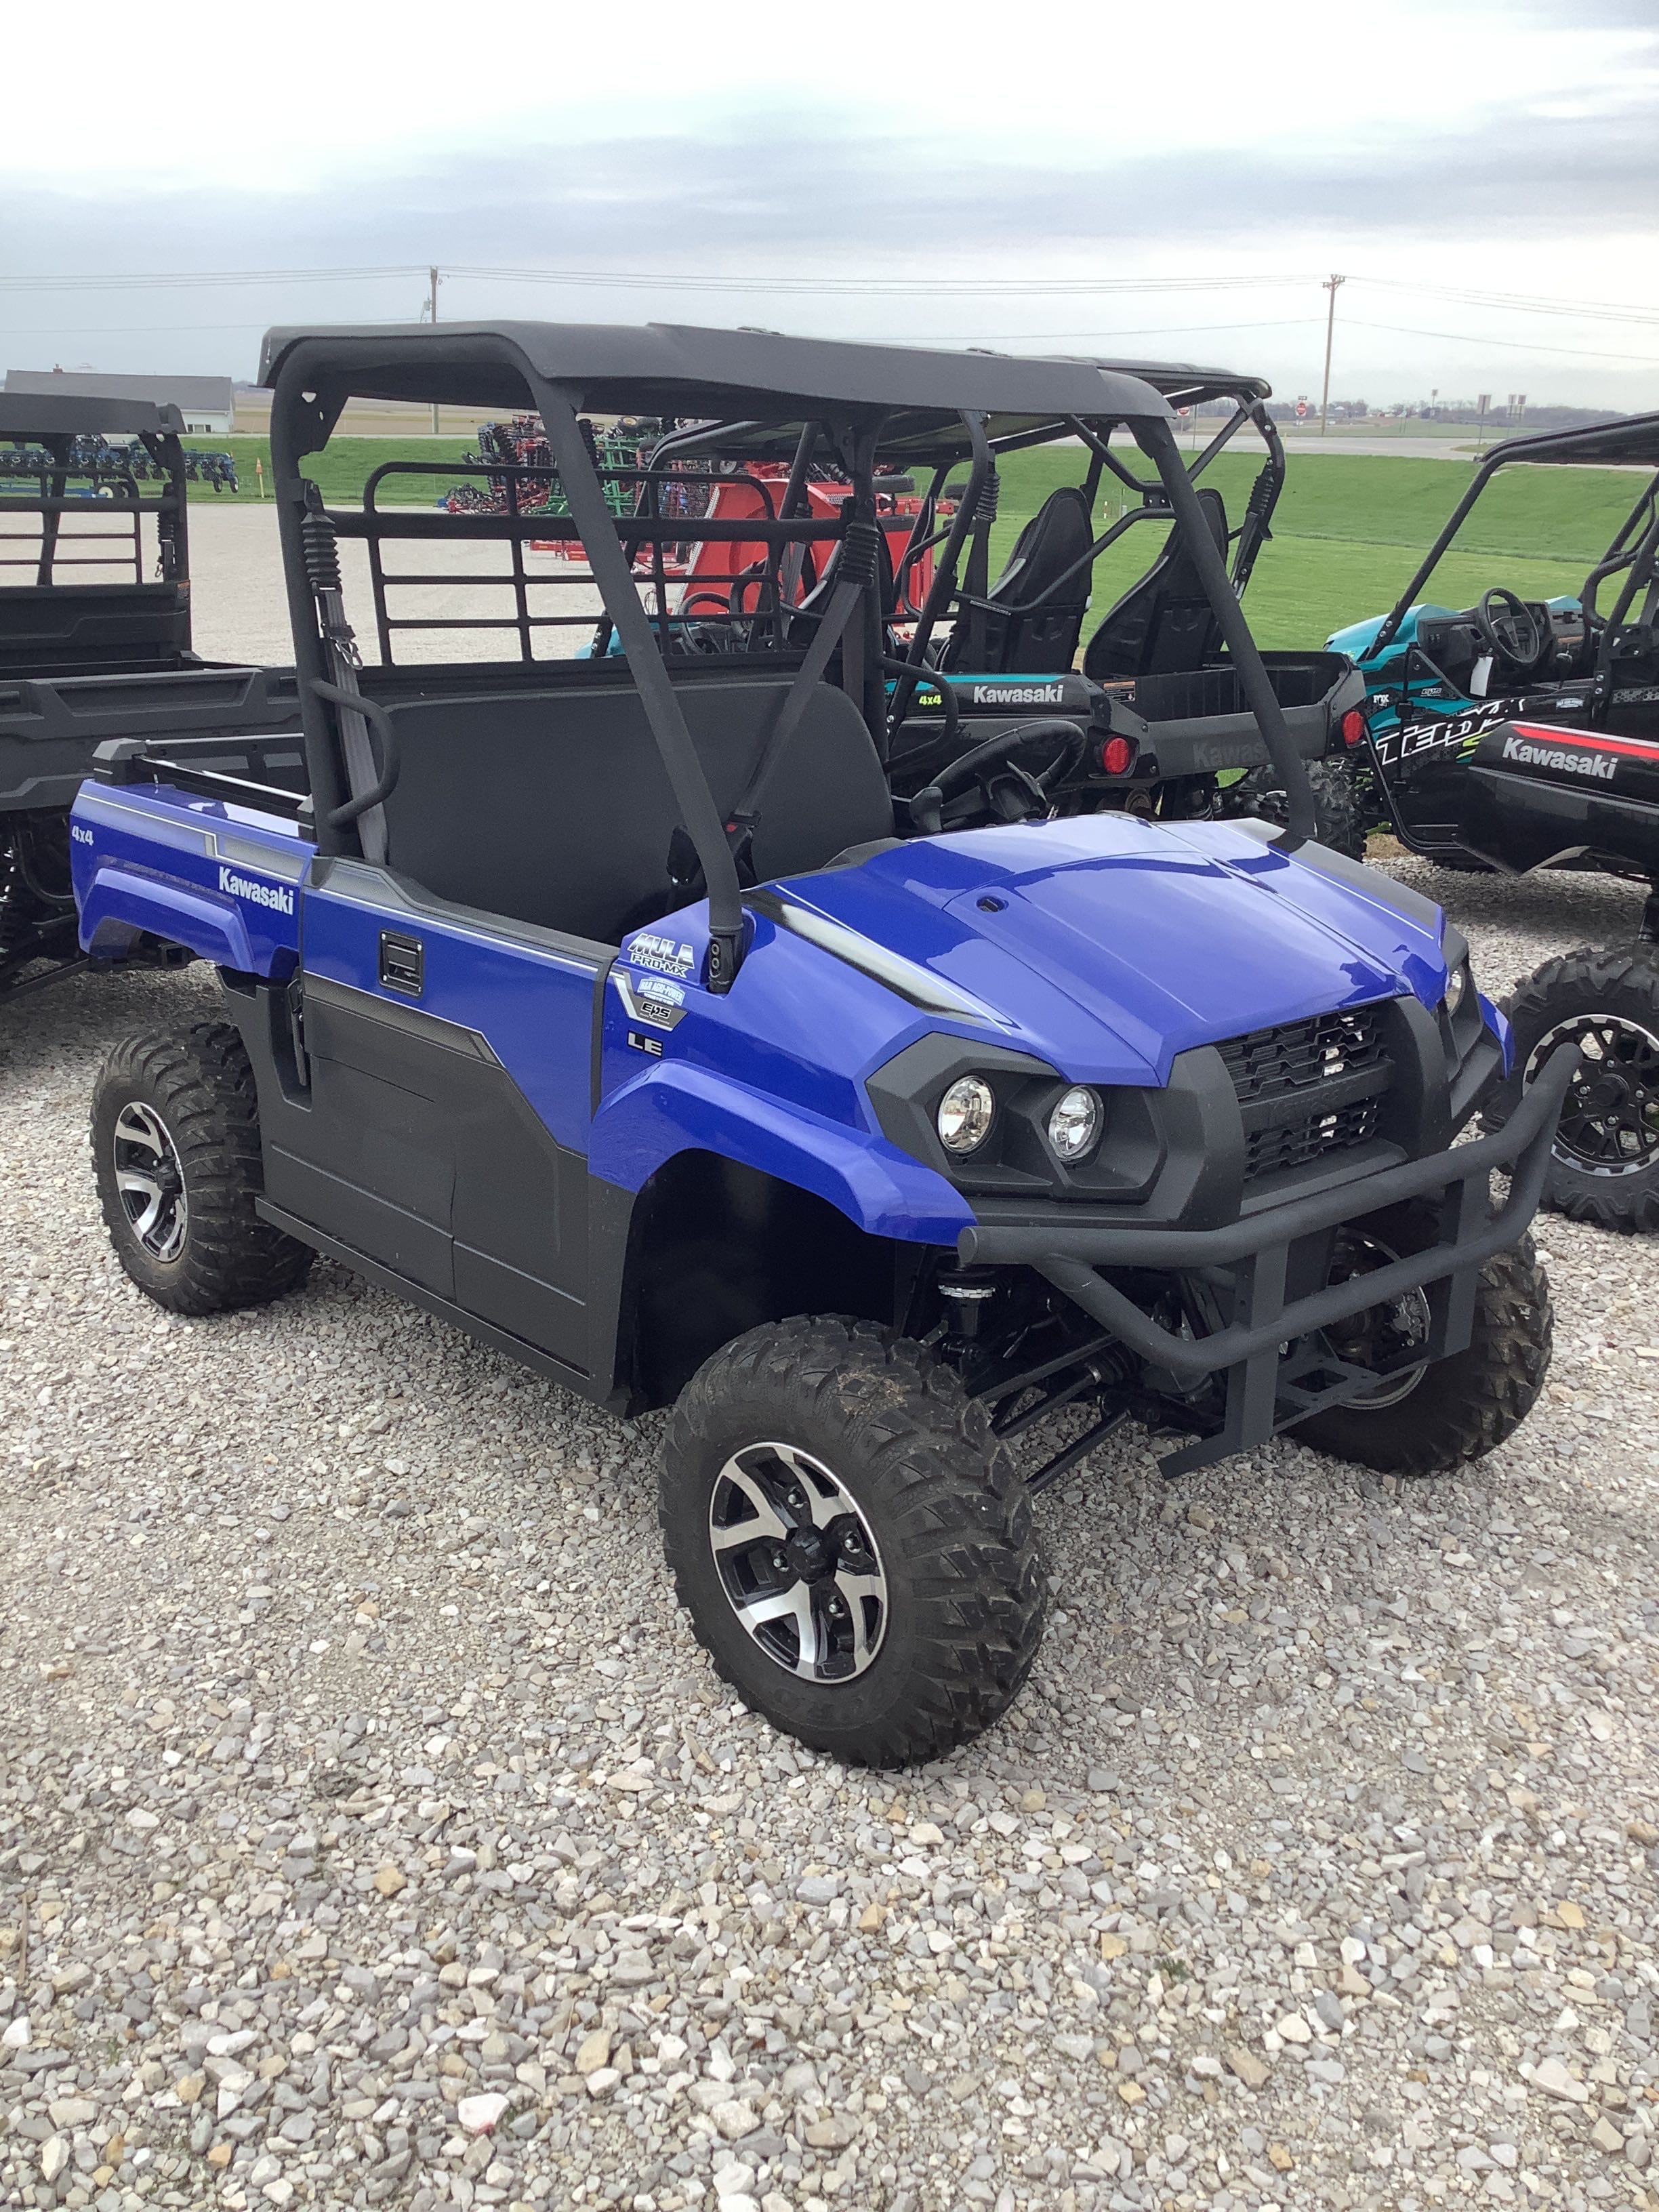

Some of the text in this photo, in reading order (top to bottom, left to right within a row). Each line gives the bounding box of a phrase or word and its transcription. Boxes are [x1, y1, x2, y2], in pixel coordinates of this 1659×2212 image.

[918, 695, 943, 705] 4x4
[973, 684, 1064, 703] Kawasaki
[1192, 741, 1271, 769] Kawas
[1502, 737, 1618, 780] Kawasaki
[71, 825, 94, 846] 4x4
[218, 866, 294, 916] Kawasaki
[630, 953, 689, 979] PRO-MX
[628, 1031, 663, 1057] LE
